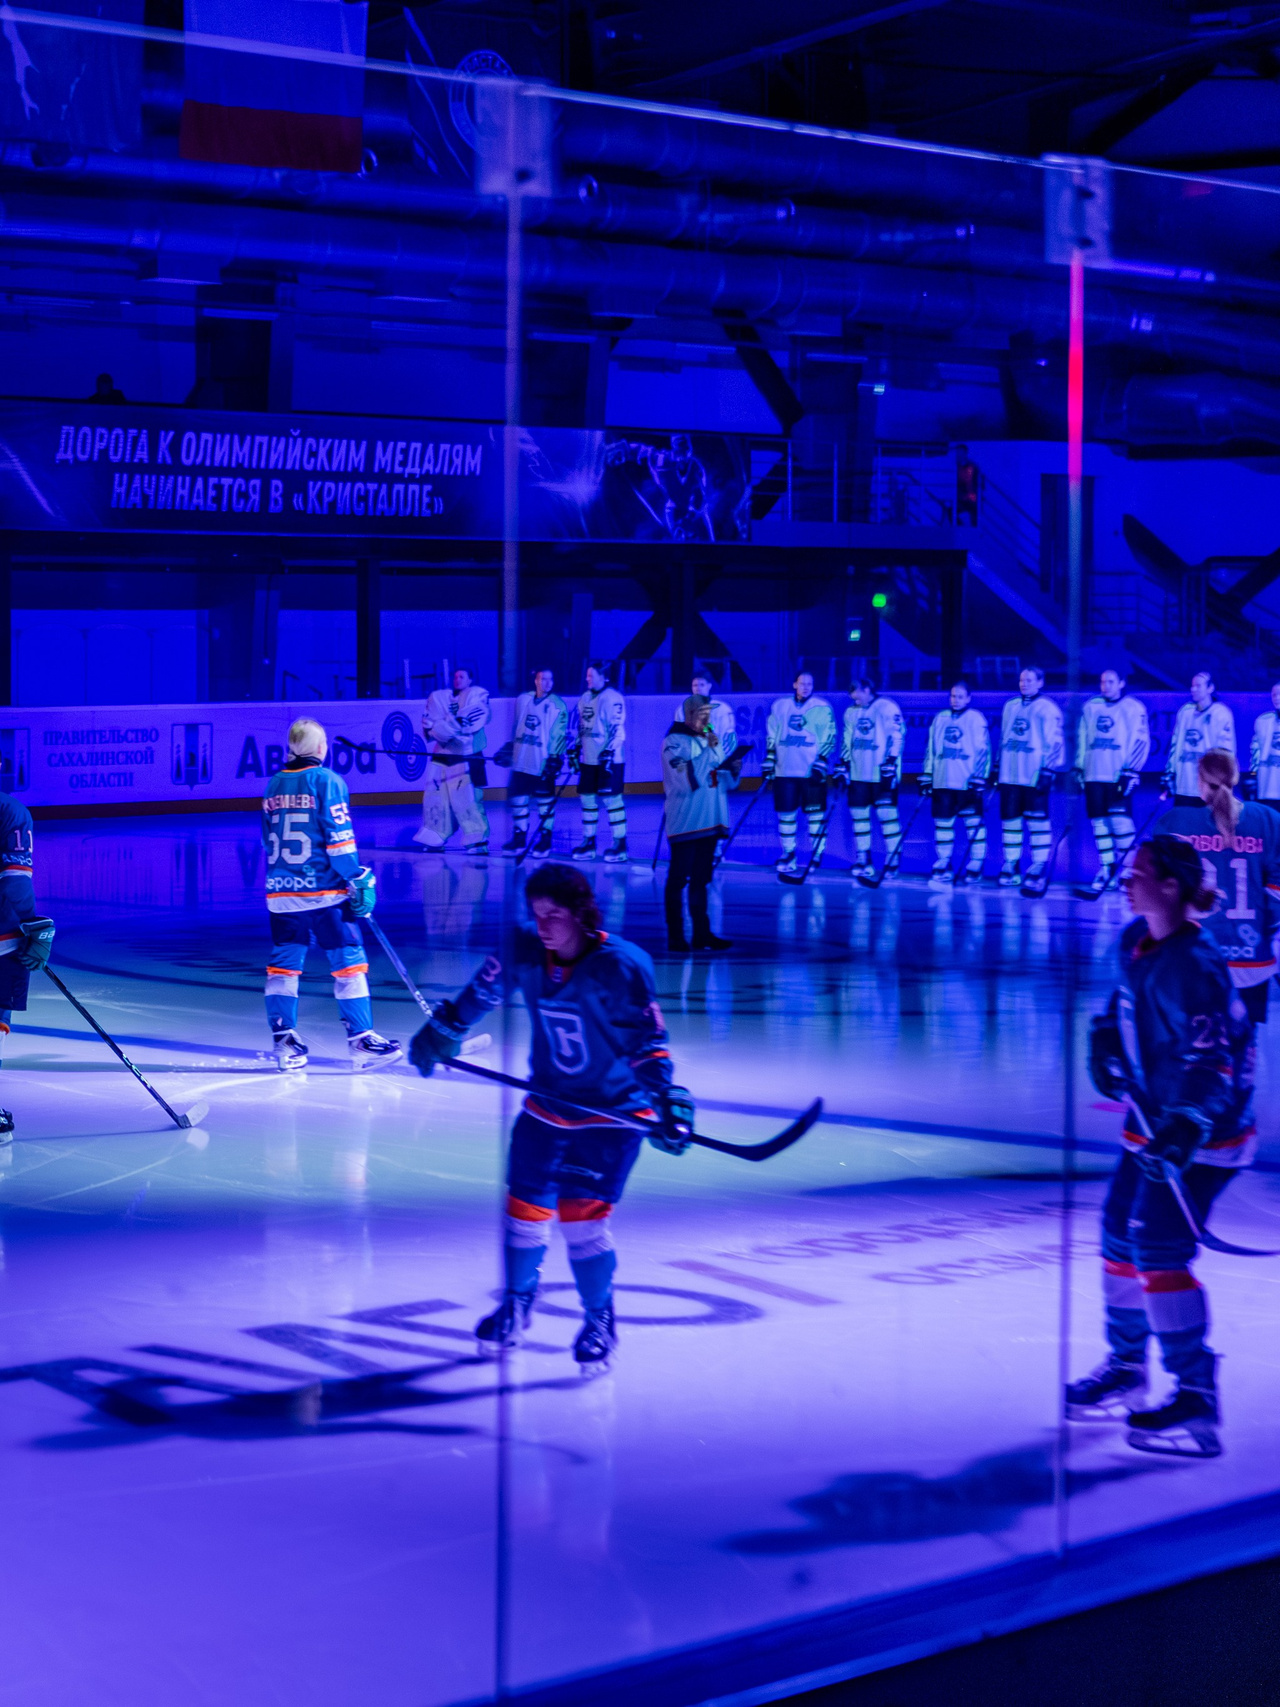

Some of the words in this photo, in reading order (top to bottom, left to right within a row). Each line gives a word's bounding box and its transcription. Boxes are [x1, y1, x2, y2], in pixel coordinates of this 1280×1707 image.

[55, 424, 150, 465] ДОРОГА
[157, 429, 176, 466] К
[180, 427, 368, 474] ОЛИМПИЙСКИМ
[373, 439, 483, 478] МЕДАЛЯМ
[110, 472, 262, 513] НАЧИНАЕТСЯ
[267, 480, 285, 514] В
[291, 480, 446, 518] «КРИСТАЛЛЕ»
[43, 728, 160, 747] ПРАВИТЕЛЬСТВО
[47, 745, 155, 769] САХАЛИНСКОЙ
[68, 771, 135, 790] ОБЛАСТИ
[13, 829, 34, 853] 11
